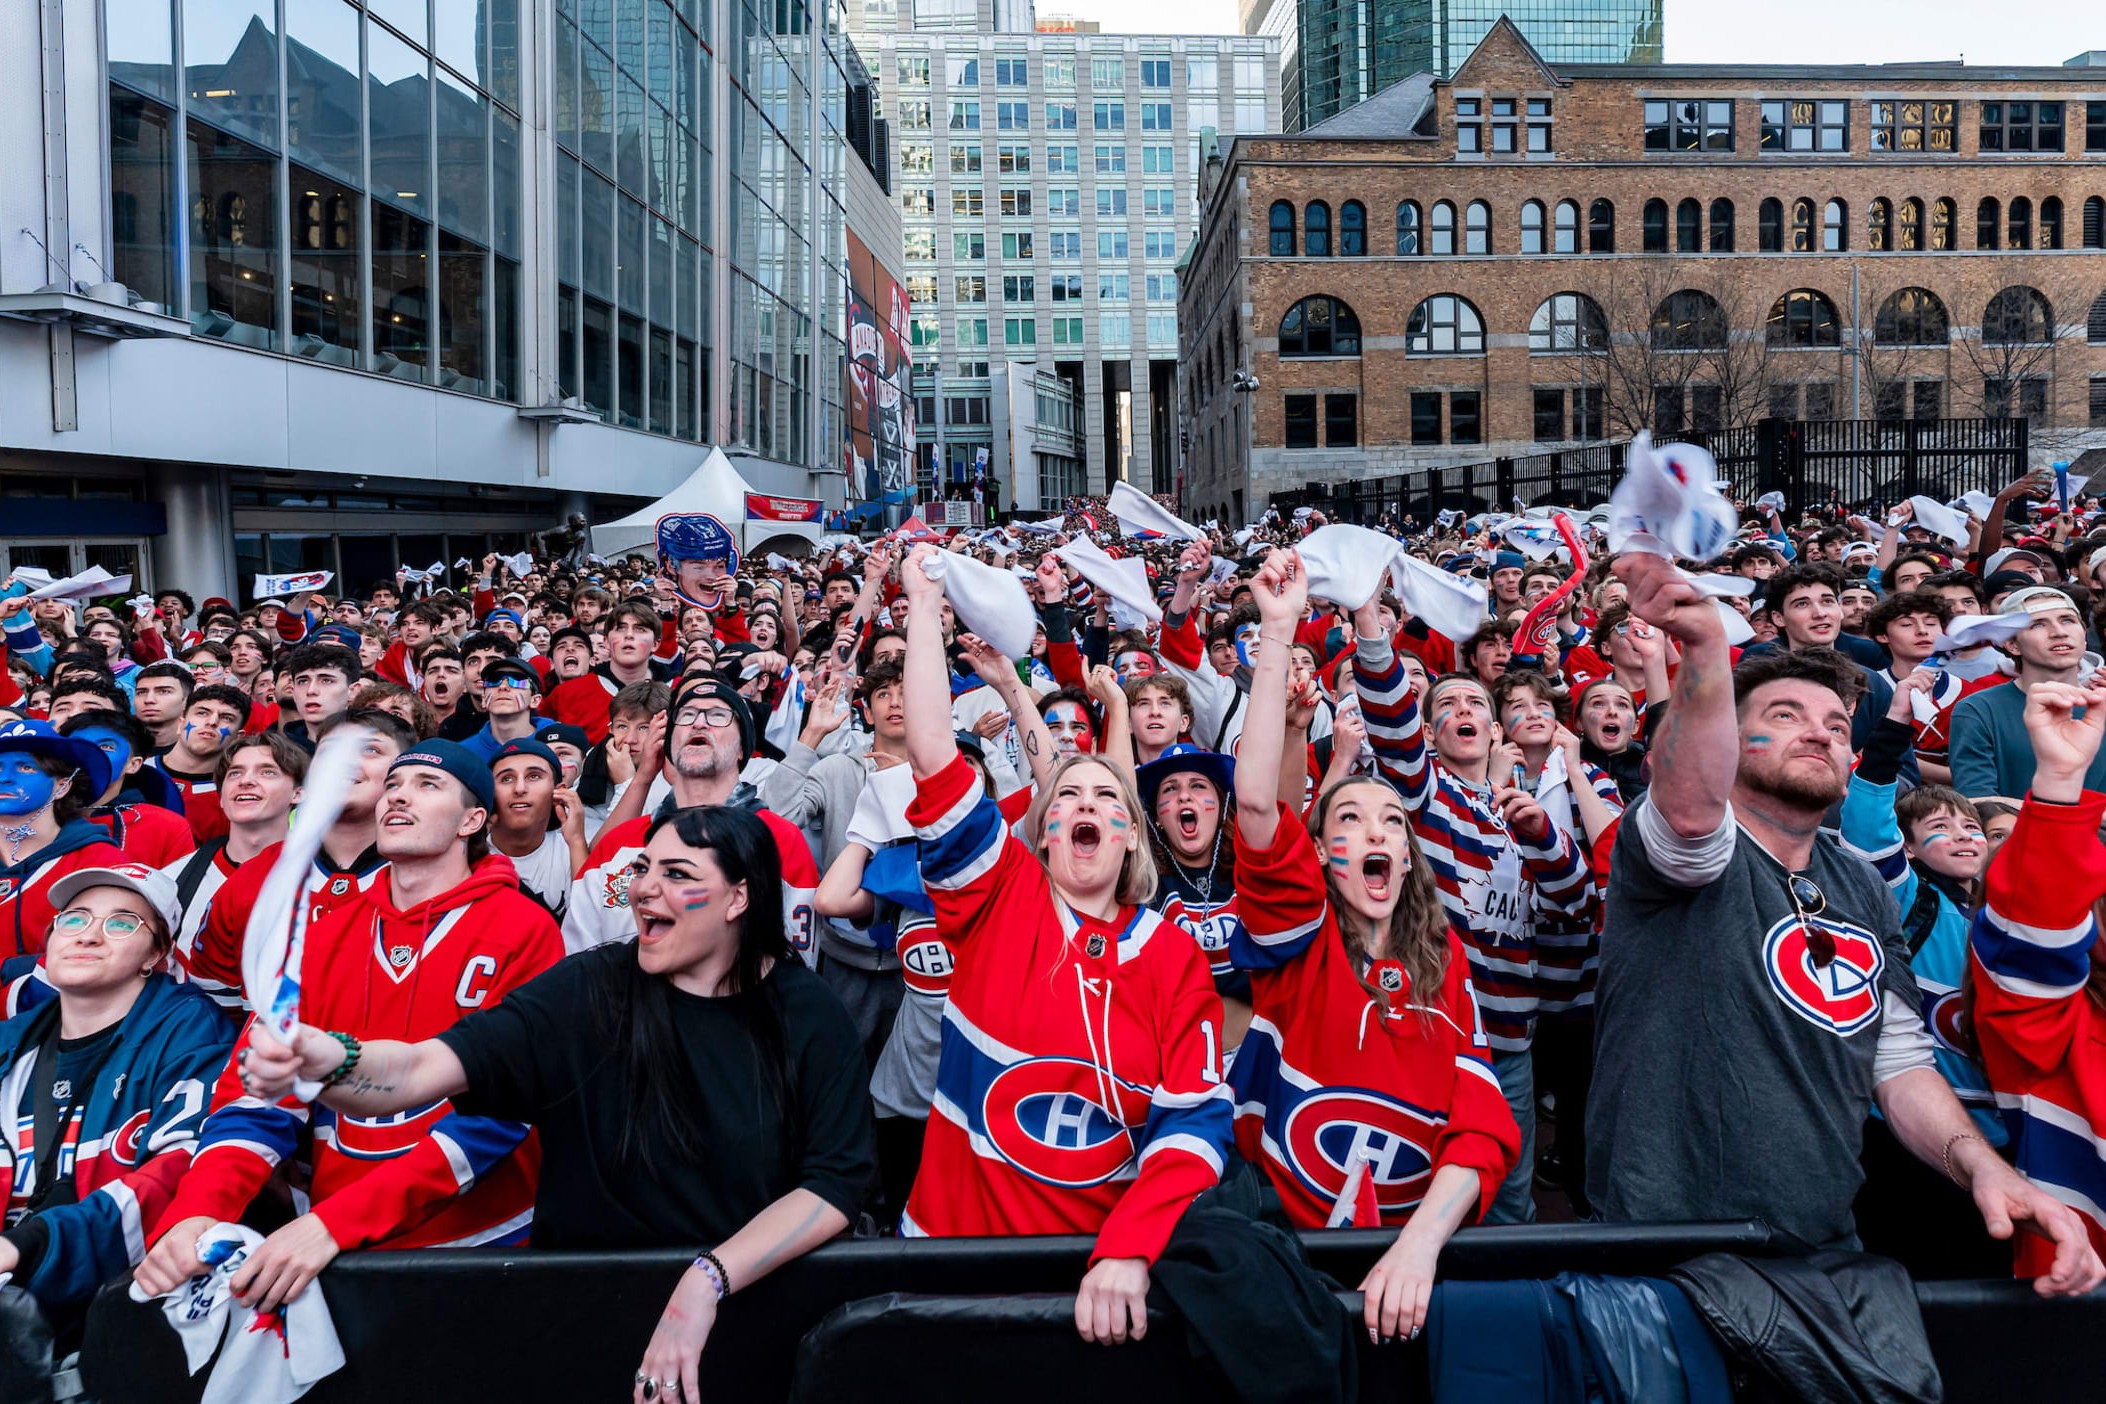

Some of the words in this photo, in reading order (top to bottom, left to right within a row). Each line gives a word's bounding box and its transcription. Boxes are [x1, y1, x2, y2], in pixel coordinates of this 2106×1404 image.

[455, 954, 497, 1008] C
[1200, 1020, 1221, 1084] 1
[147, 1078, 212, 1152] 2
